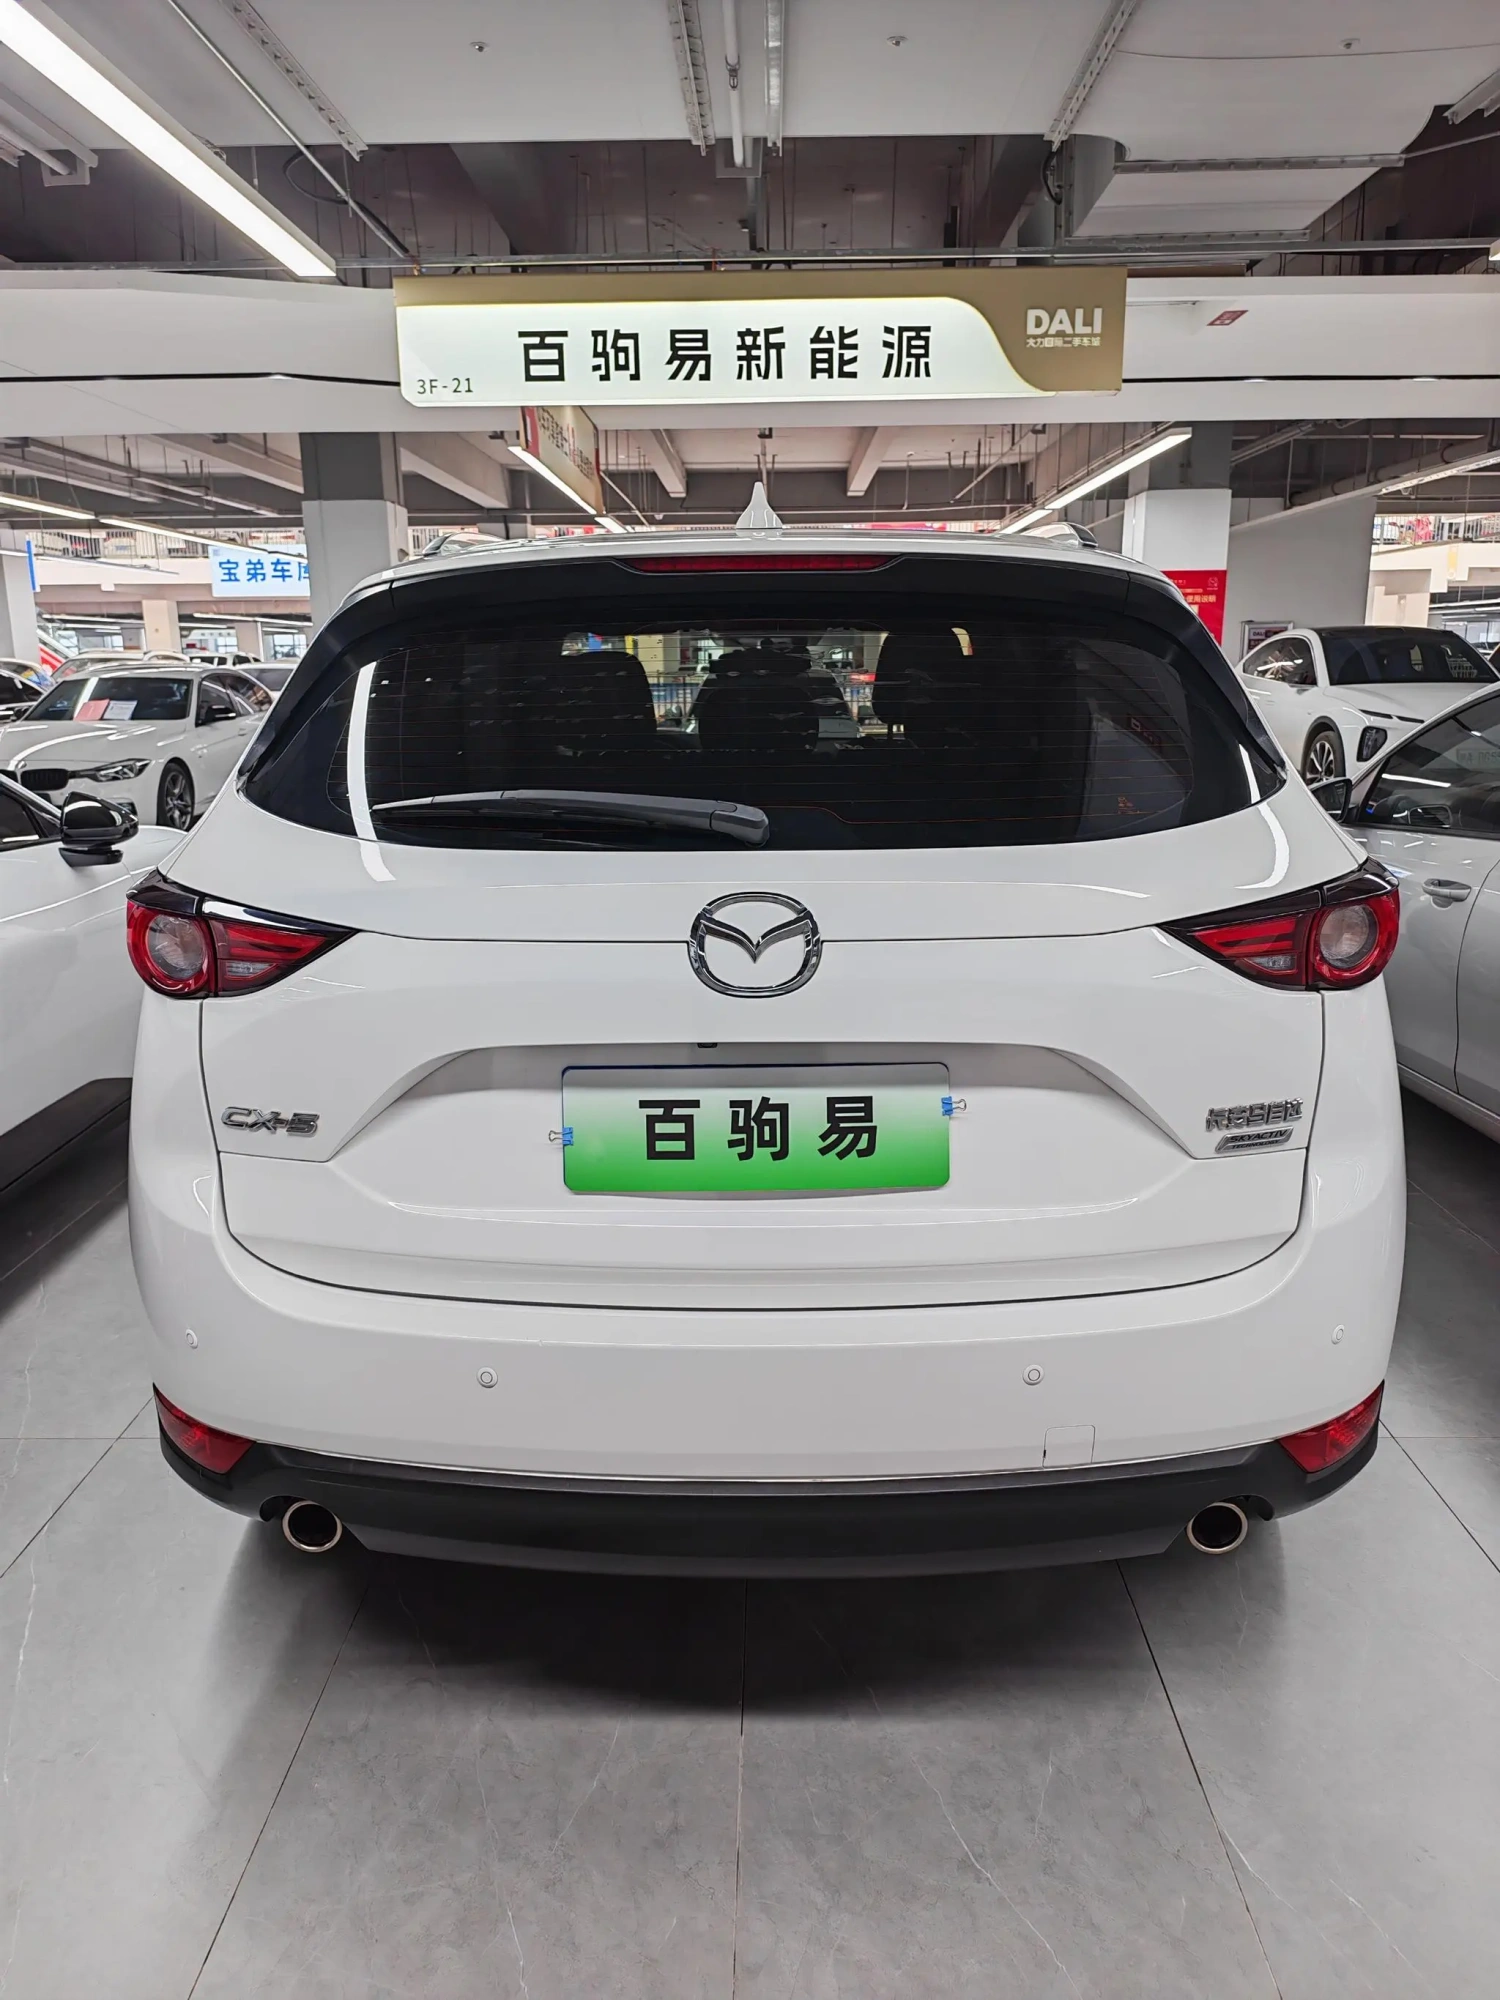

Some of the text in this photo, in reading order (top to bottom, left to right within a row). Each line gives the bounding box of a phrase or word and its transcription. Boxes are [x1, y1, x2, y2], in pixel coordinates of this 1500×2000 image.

[1026, 308, 1102, 335] DALI
[517, 325, 932, 382] 百驹易新能源
[417, 377, 473, 394] 3F-21
[221, 1106, 320, 1137] CX-5
[638, 1095, 878, 1162] 百驹易
[1230, 1129, 1288, 1142] SKYACTIV
[1231, 1140, 1281, 1149] TECHNOLOGY
